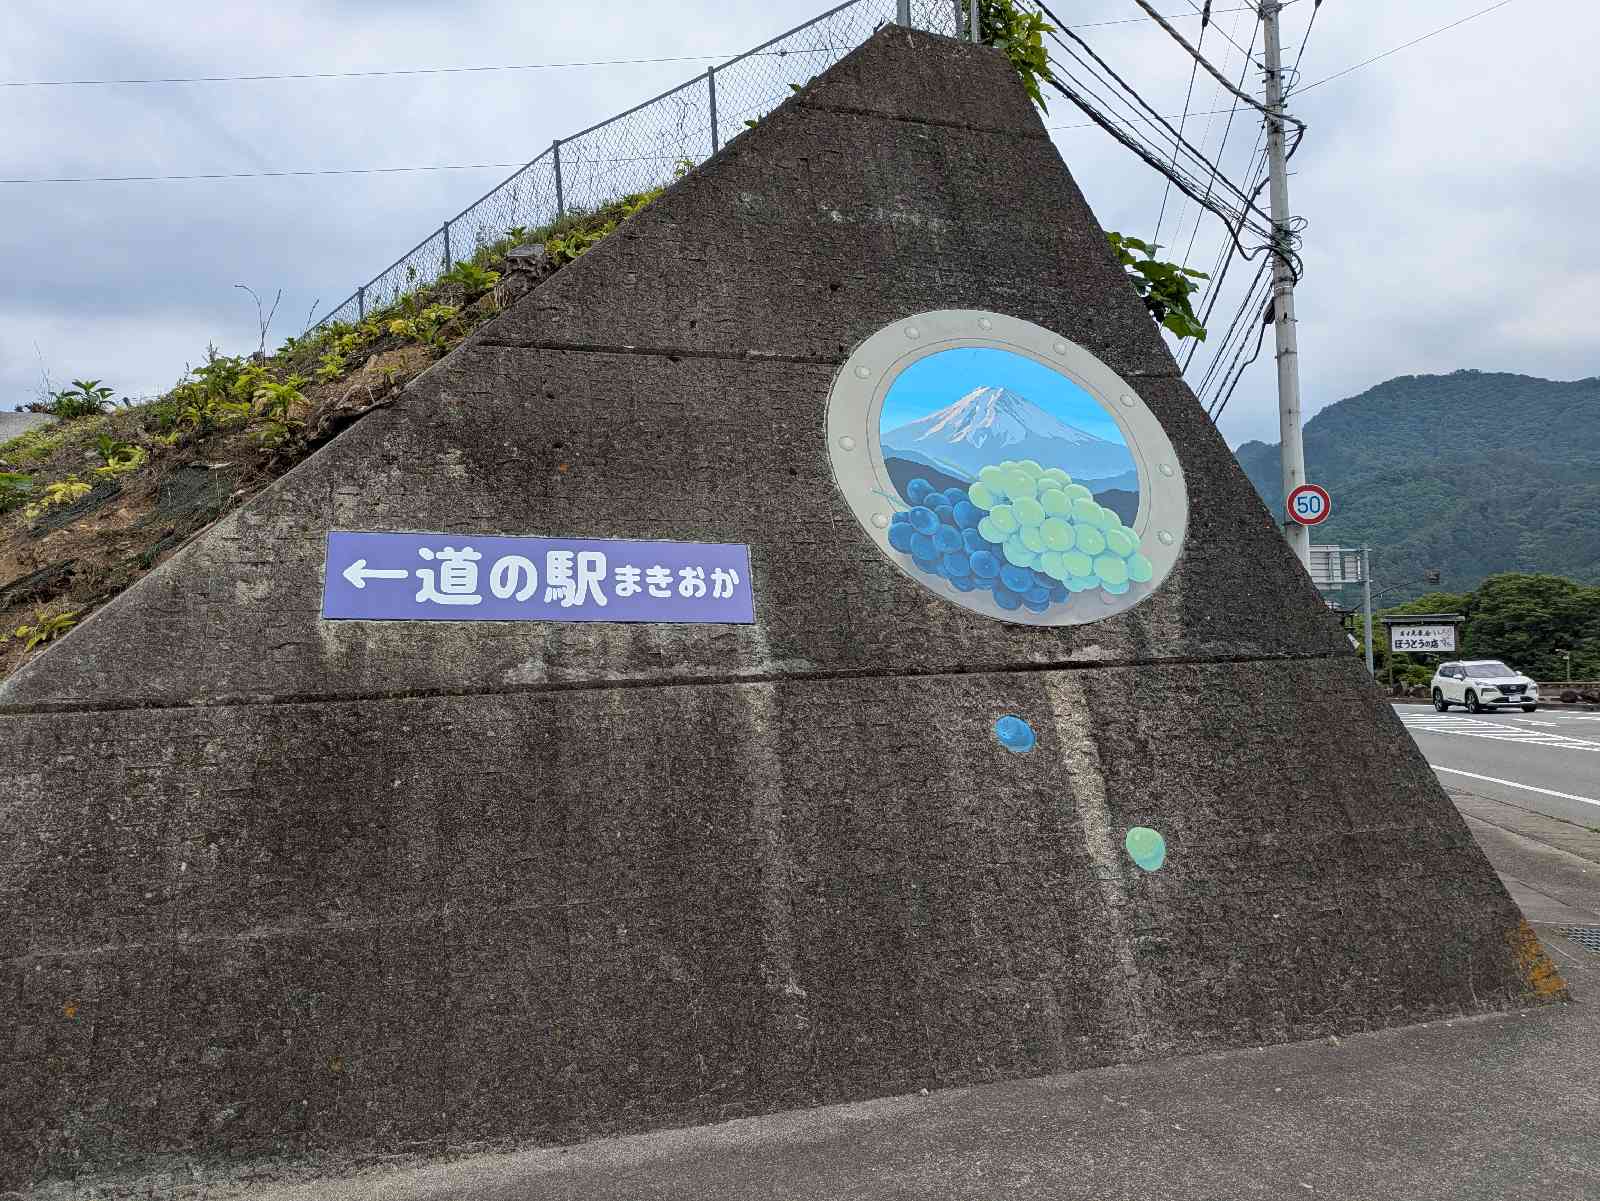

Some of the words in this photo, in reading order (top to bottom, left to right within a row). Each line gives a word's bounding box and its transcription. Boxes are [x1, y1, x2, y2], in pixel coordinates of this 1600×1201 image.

[1297, 495, 1321, 514] 50
[415, 546, 608, 608] 道の駅
[614, 564, 740, 599] まきおか
